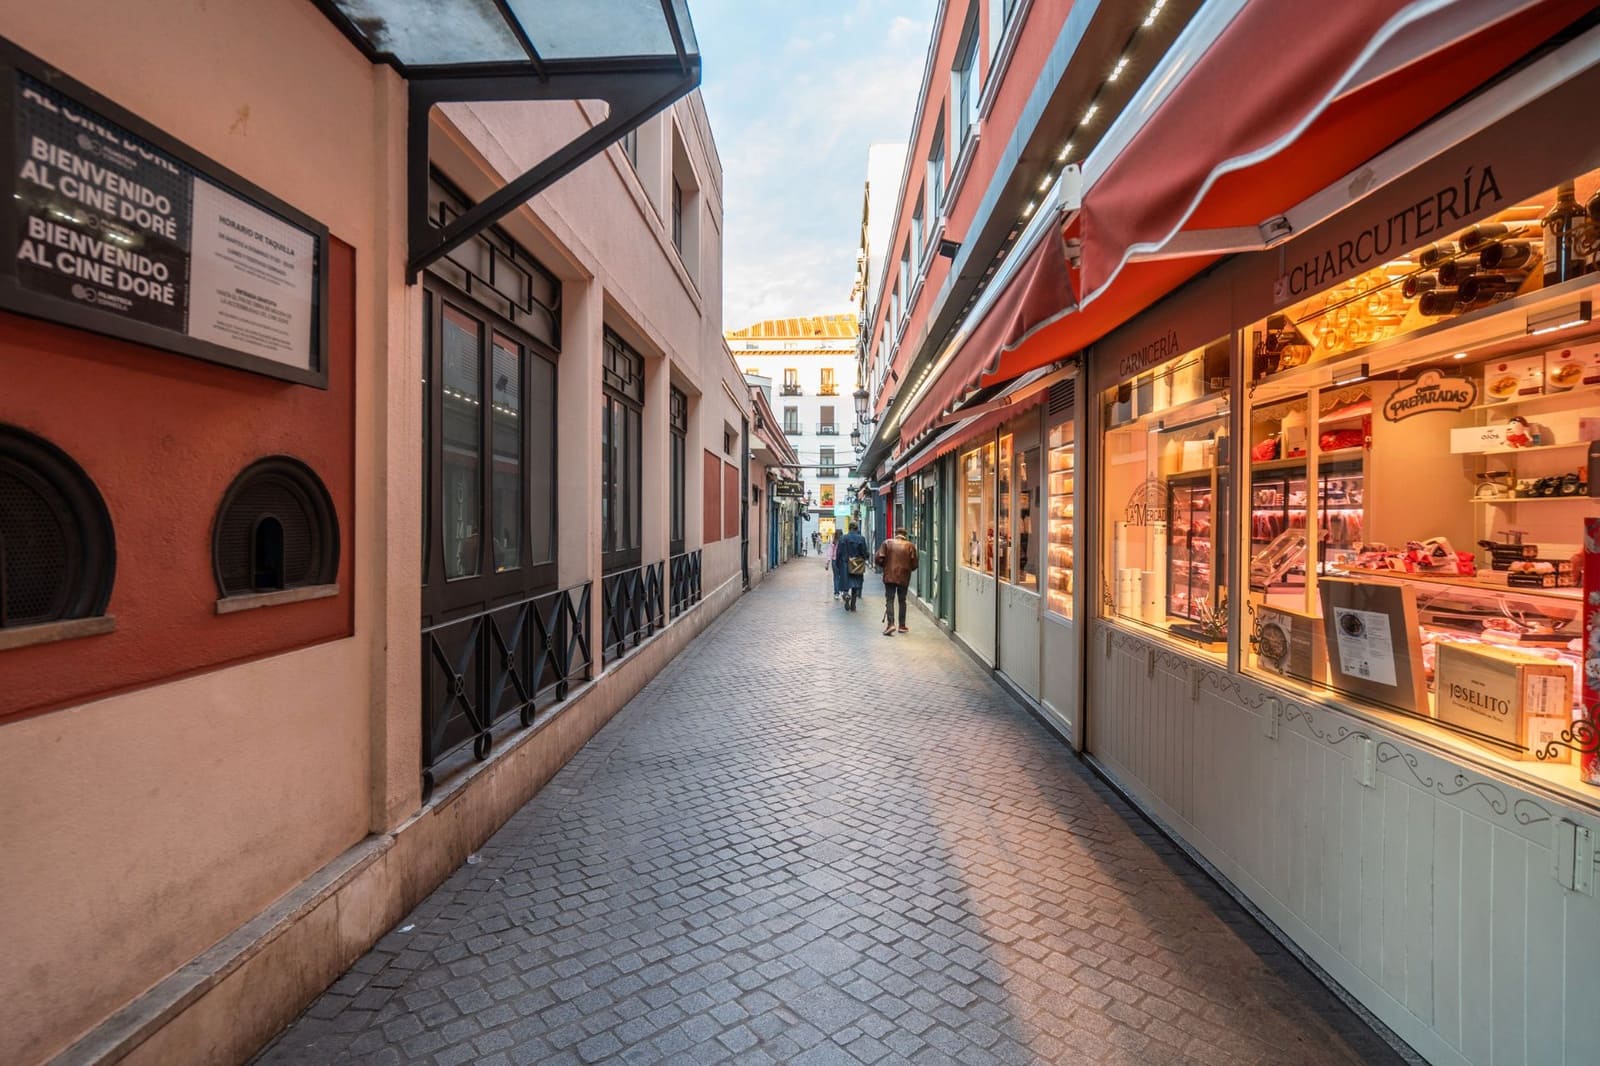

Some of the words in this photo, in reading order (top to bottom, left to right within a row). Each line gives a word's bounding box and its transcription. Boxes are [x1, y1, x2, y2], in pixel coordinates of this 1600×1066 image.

[19, 159, 56, 191] AL
[58, 175, 118, 216] CINE
[119, 201, 178, 241] DORÉ
[30, 135, 172, 216] BIENVENIDO
[28, 215, 170, 282] BIENVENIDO
[1288, 164, 1504, 297] CHARCUTERÍA
[17, 239, 53, 269] AL
[55, 252, 115, 289] CINE
[116, 270, 176, 307] DORÉ
[1119, 327, 1180, 378] CARNICERÍA
[1390, 390, 1469, 417] PREPARADAS
[1450, 682, 1509, 716] JOSELITO
